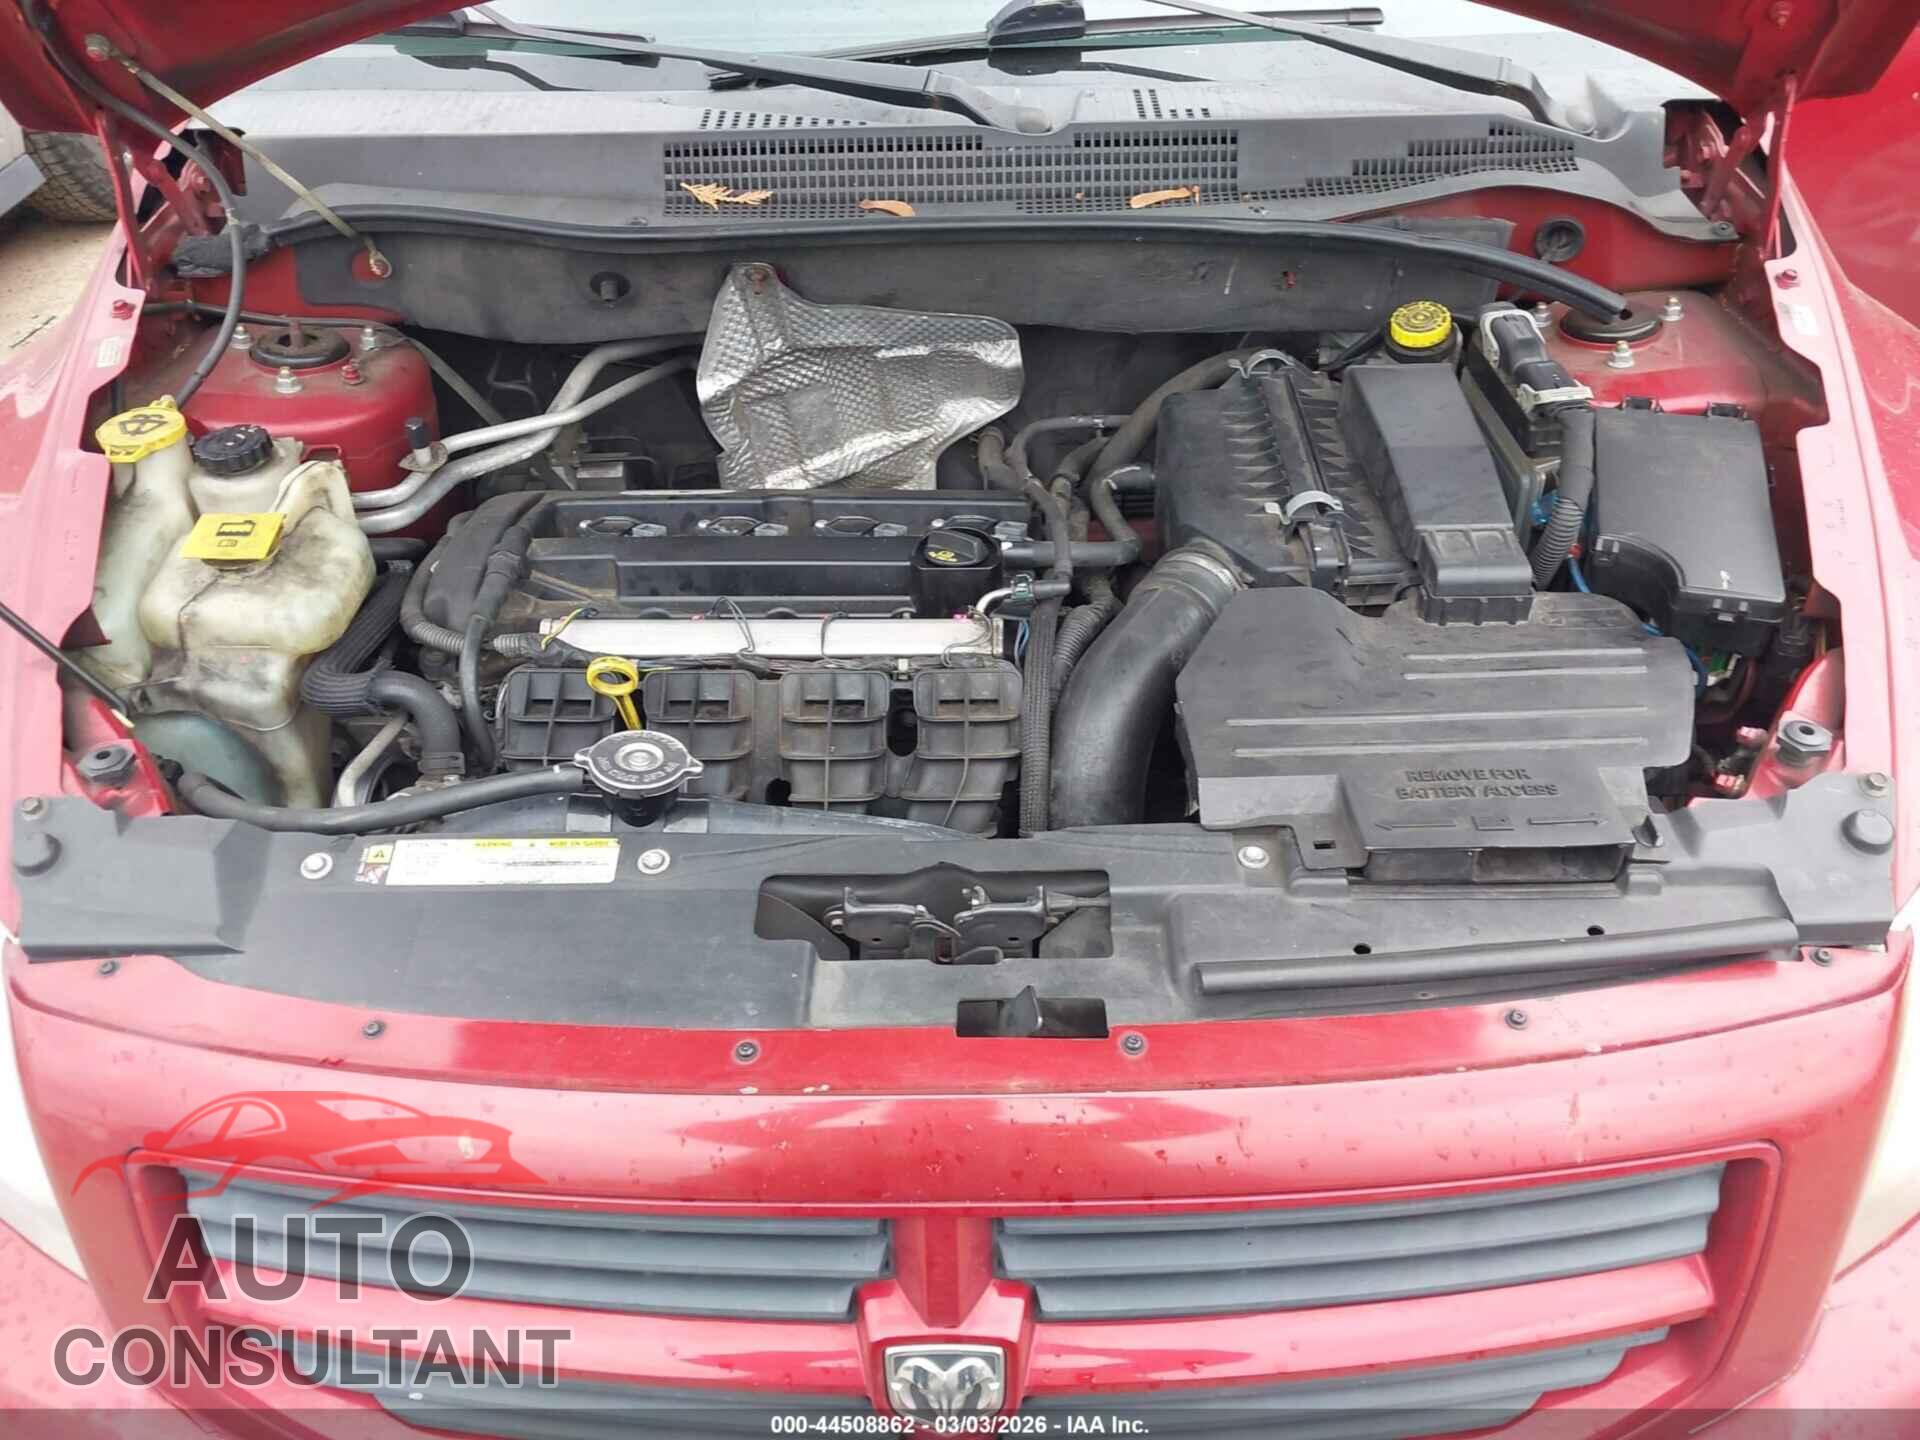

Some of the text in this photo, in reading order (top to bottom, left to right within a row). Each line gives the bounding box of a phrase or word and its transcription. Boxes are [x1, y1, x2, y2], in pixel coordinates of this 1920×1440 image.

[1405, 767, 1532, 783] REMOVE FOR
[1395, 783, 1560, 800] BATTERY ACCESS
